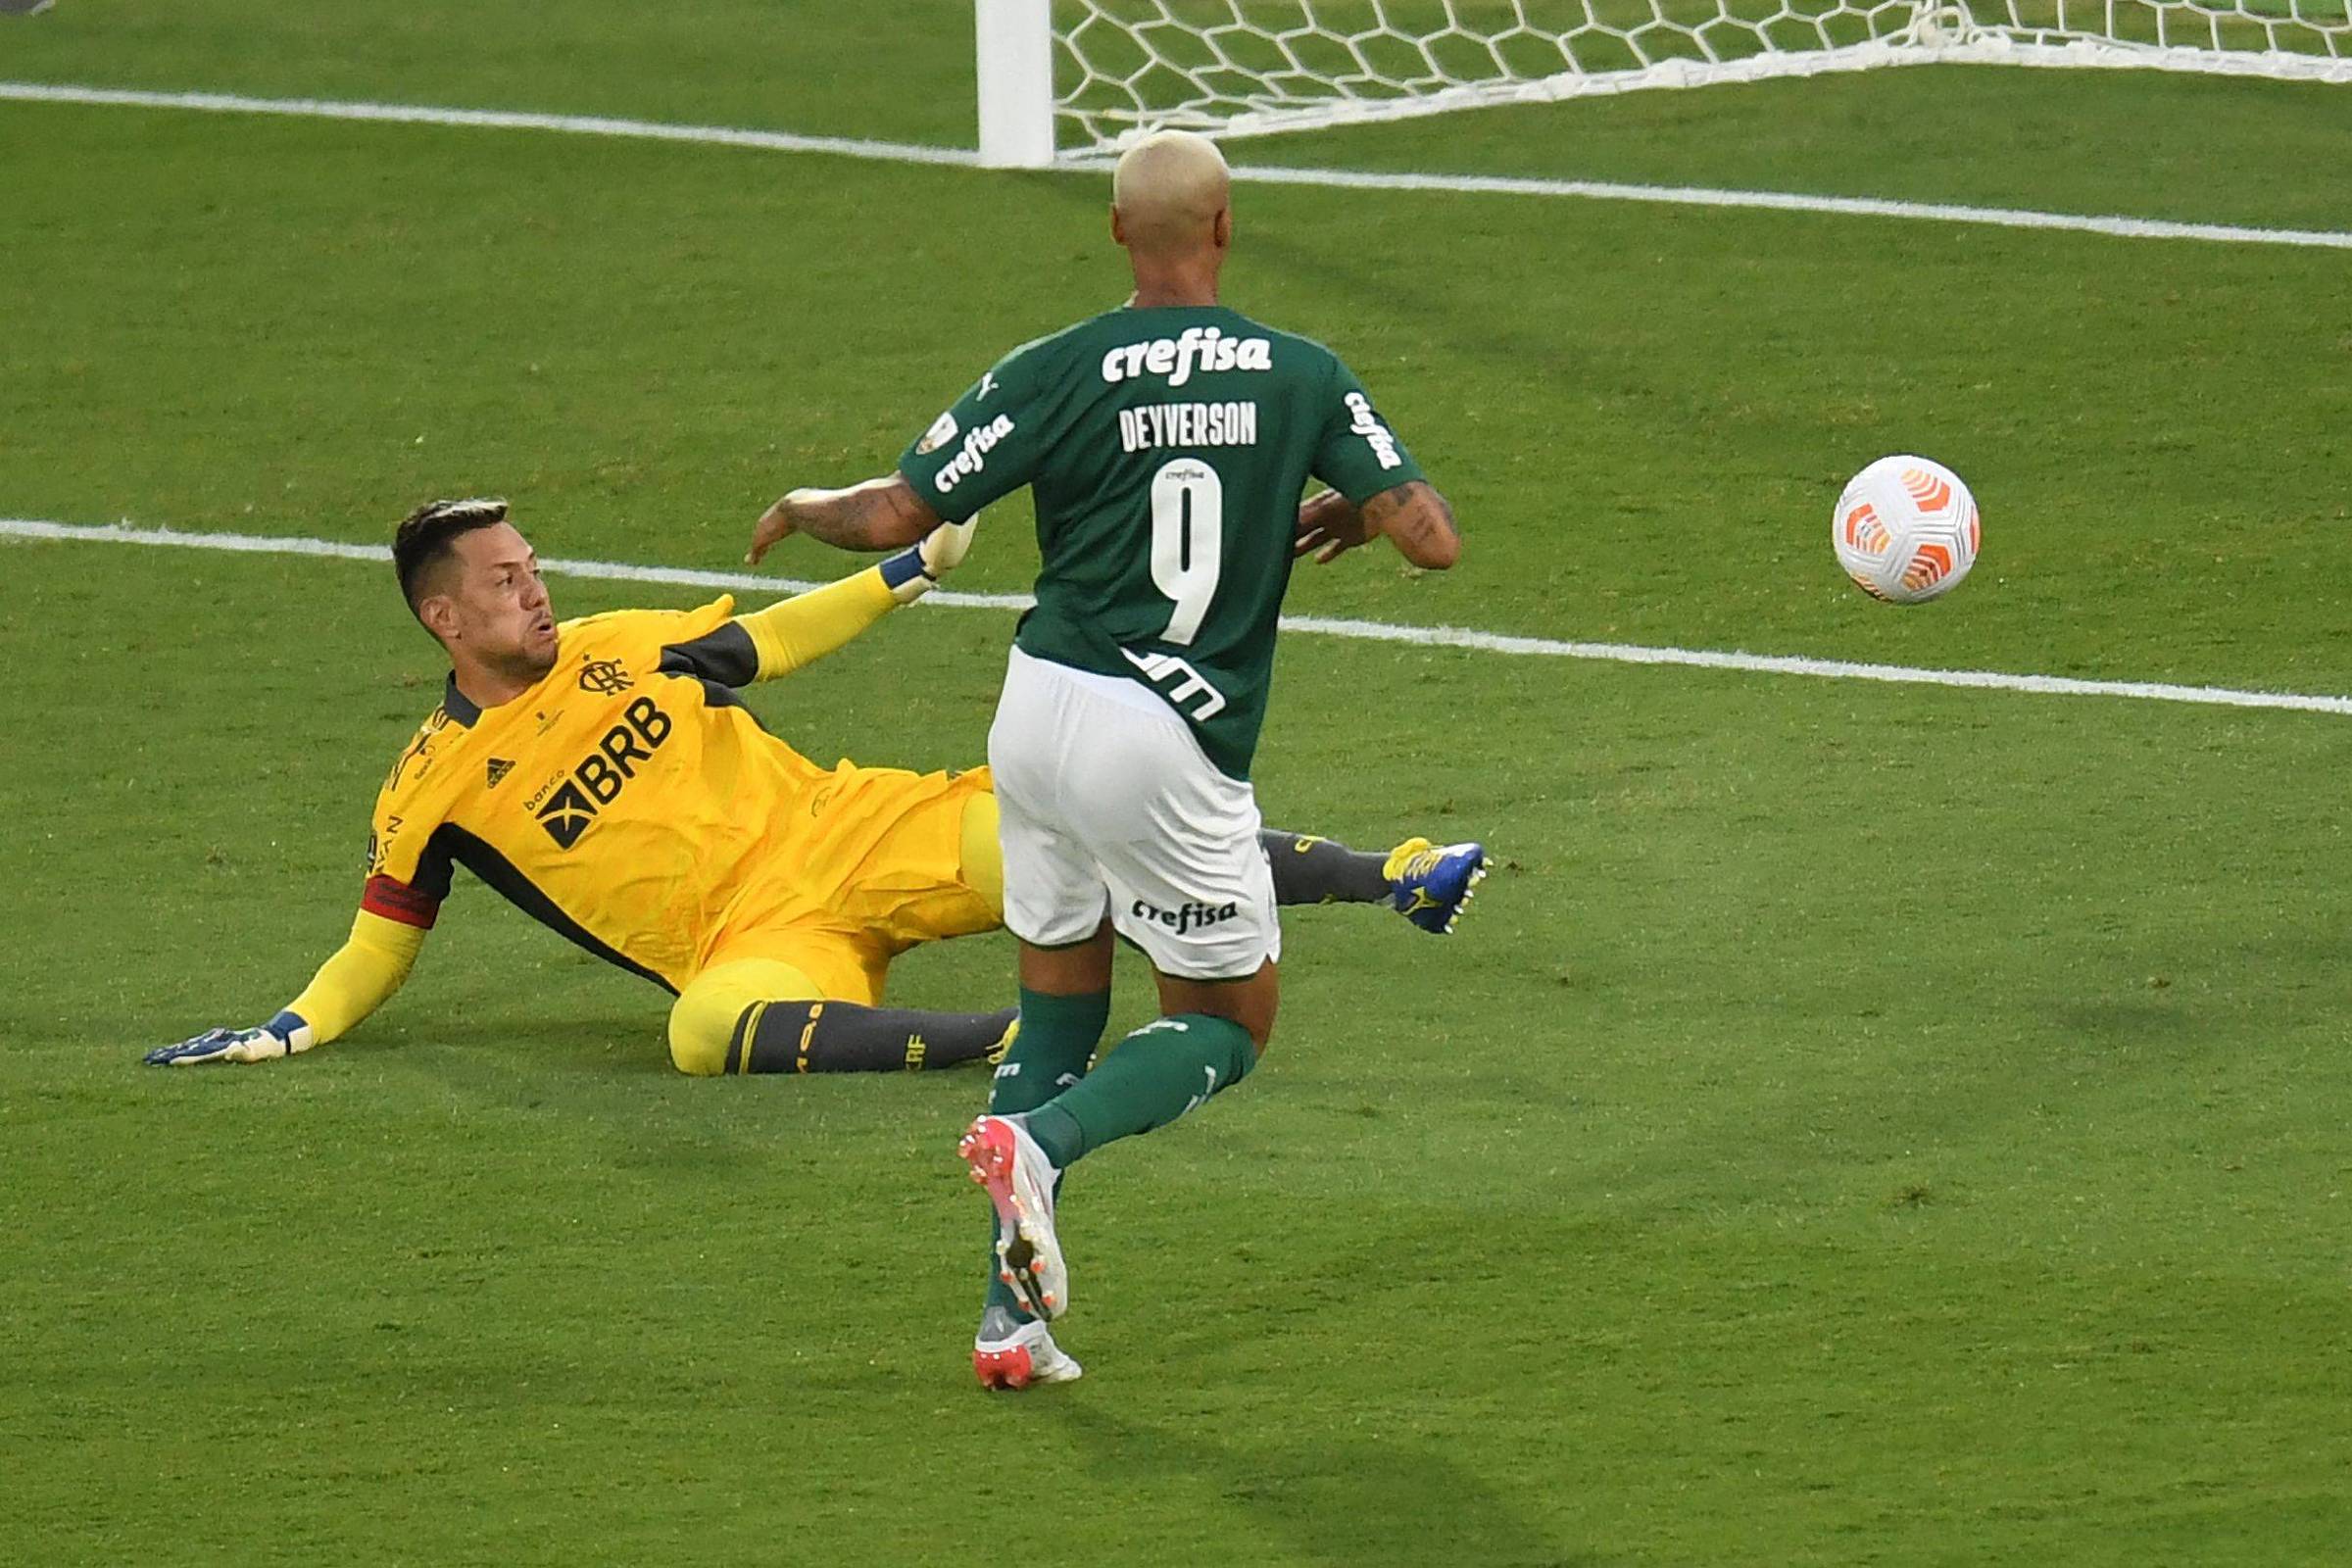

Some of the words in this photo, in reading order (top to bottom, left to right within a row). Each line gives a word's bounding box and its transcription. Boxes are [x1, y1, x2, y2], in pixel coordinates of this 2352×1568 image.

[1102, 327, 1272, 386] crefisa
[935, 414, 1015, 493] crefisa
[1119, 402, 1256, 452] DEYVERSON
[1151, 457, 1223, 647] 9
[574, 696, 672, 806] BRB
[523, 768, 565, 811] banco
[1132, 900, 1238, 935] crefisa
